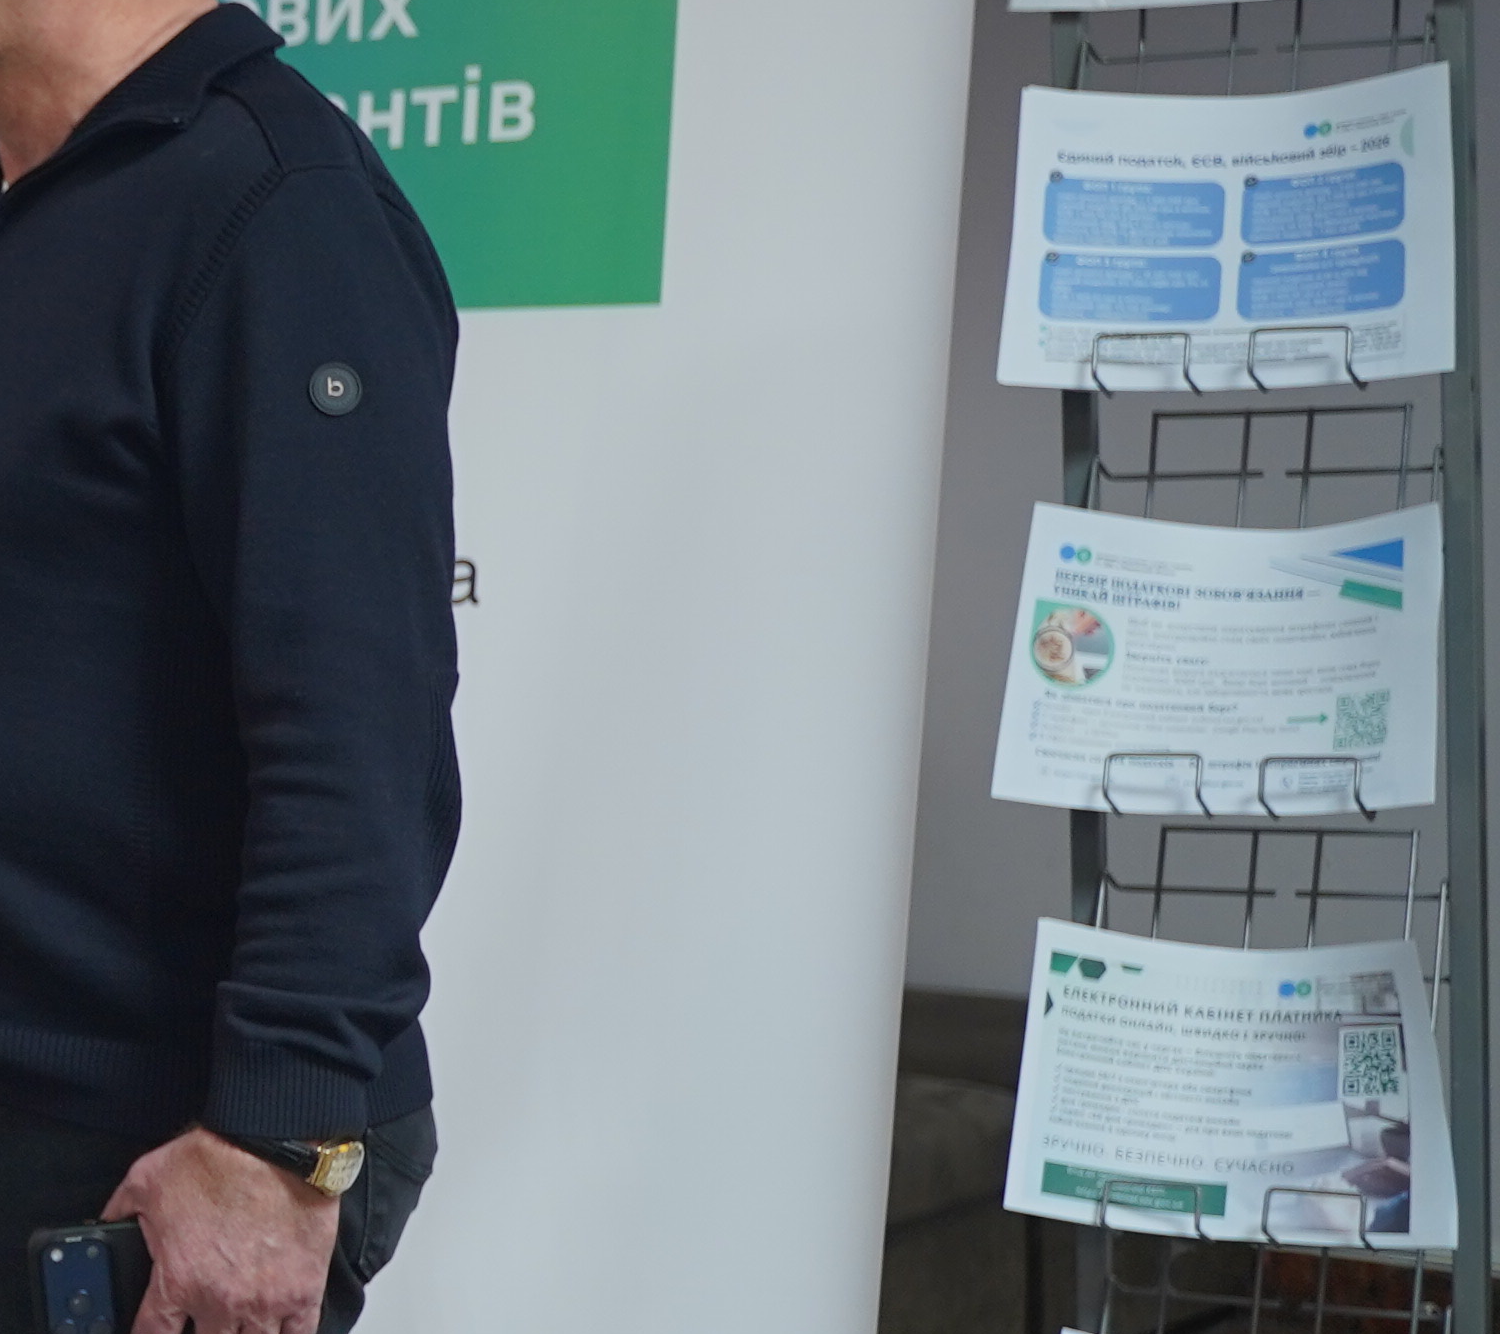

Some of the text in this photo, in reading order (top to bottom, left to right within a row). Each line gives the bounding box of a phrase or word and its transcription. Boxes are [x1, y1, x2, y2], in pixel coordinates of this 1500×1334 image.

[1062, 983, 1343, 1024] ЕЛЕКТРОННИЙ КАБІНЕТ ПЛАТНИКА
